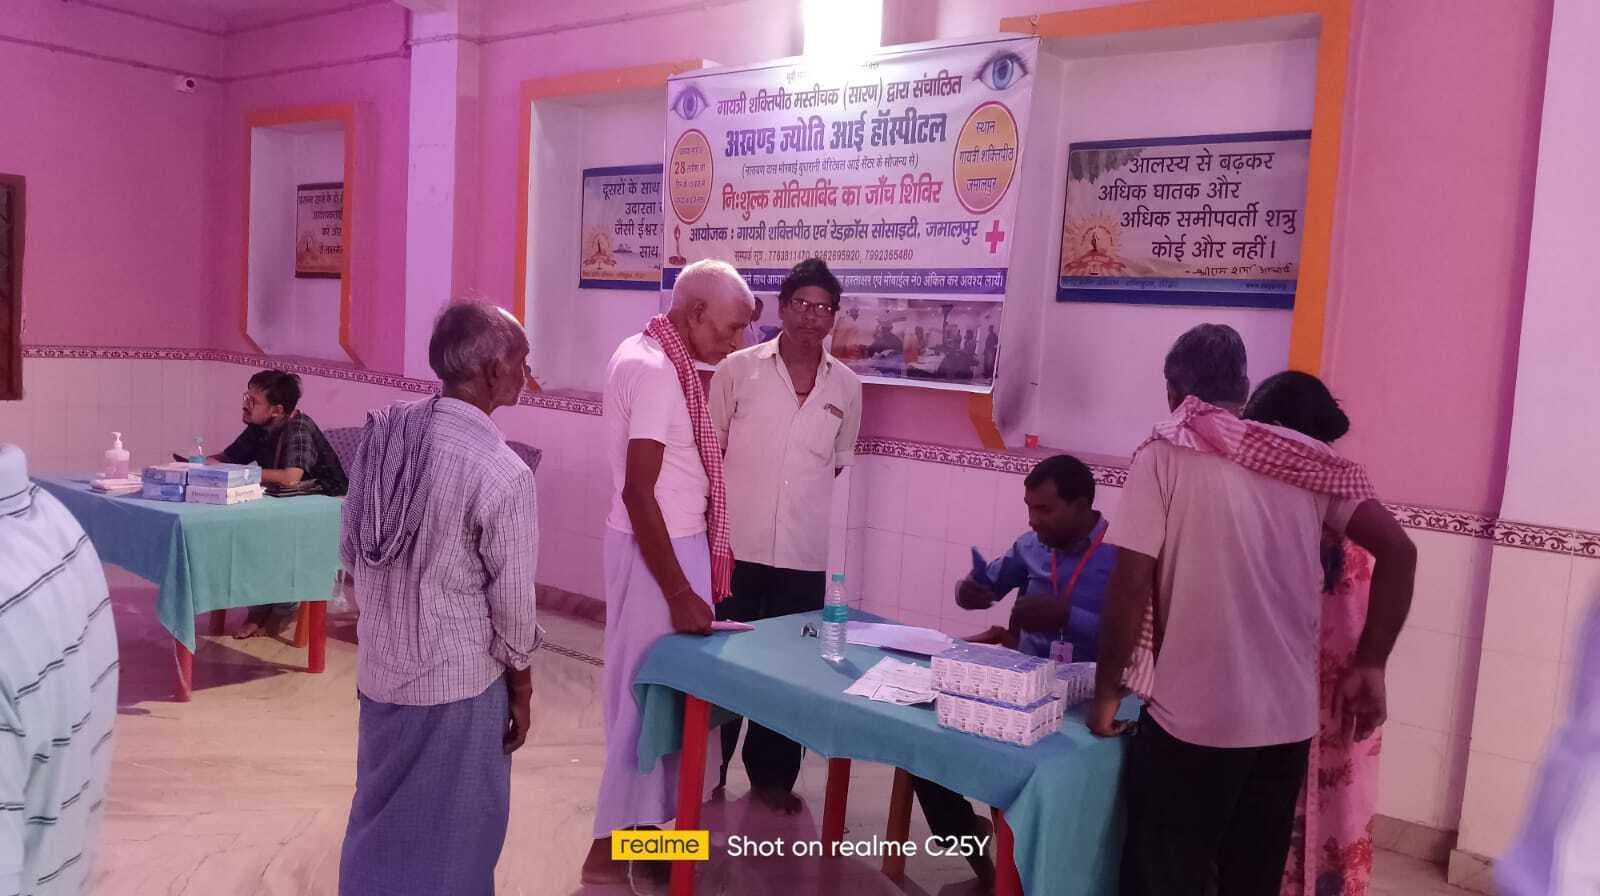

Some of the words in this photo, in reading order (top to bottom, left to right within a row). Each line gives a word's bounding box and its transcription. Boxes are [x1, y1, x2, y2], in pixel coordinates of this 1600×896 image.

[716, 90, 747, 116] गायत्री
[749, 86, 793, 114] शक्तिपीठ
[794, 83, 841, 109] मस्तीचक
[843, 77, 883, 112] (सारण)
[886, 81, 911, 103] द्वारा
[912, 69, 963, 98] संचालित
[725, 128, 776, 157] अखण्ड
[780, 115, 826, 152] ज्योति
[830, 110, 867, 152] आई
[870, 107, 947, 147] हॉस्पीटल
[976, 120, 996, 135] स्थान
[959, 145, 980, 163] गायत्री
[980, 143, 1015, 161] शक्तिपीठ
[1128, 155, 1191, 173] आलस्य
[1196, 148, 1214, 171] से
[1219, 152, 1275, 175] बढ़कर
[674, 160, 686, 175] 28
[602, 178, 626, 200] दूसरों
[627, 178, 638, 195] के
[640, 181, 661, 195] साथ
[721, 182, 771, 218] निःशुल्क
[772, 178, 839, 210] मोतियाबिंद
[841, 185, 862, 207] का
[865, 175, 897, 206] जाँच
[899, 172, 944, 205] शिविर
[1098, 178, 1147, 201] अधिक
[1152, 182, 1202, 201] घातक
[1206, 174, 1242, 200] और
[624, 202, 657, 215] उदारता
[1120, 205, 1172, 228] अधिक
[1176, 201, 1261, 228] समीपवर्ती
[1264, 208, 1297, 234] शत्रु
[614, 217, 635, 236] जैसी
[637, 217, 659, 238] ईश्वर
[689, 224, 729, 242] आयोजक
[736, 220, 767, 241] गायत्री
[768, 218, 812, 241] शक्तिपीठ
[812, 219, 831, 241] एवं
[830, 217, 869, 241] रेडक्रॉस
[871, 216, 921, 241] सोसाइटी,
[925, 220, 980, 245] जमालपुर
[1151, 232, 1186, 262] कोई
[1191, 234, 1227, 259] और
